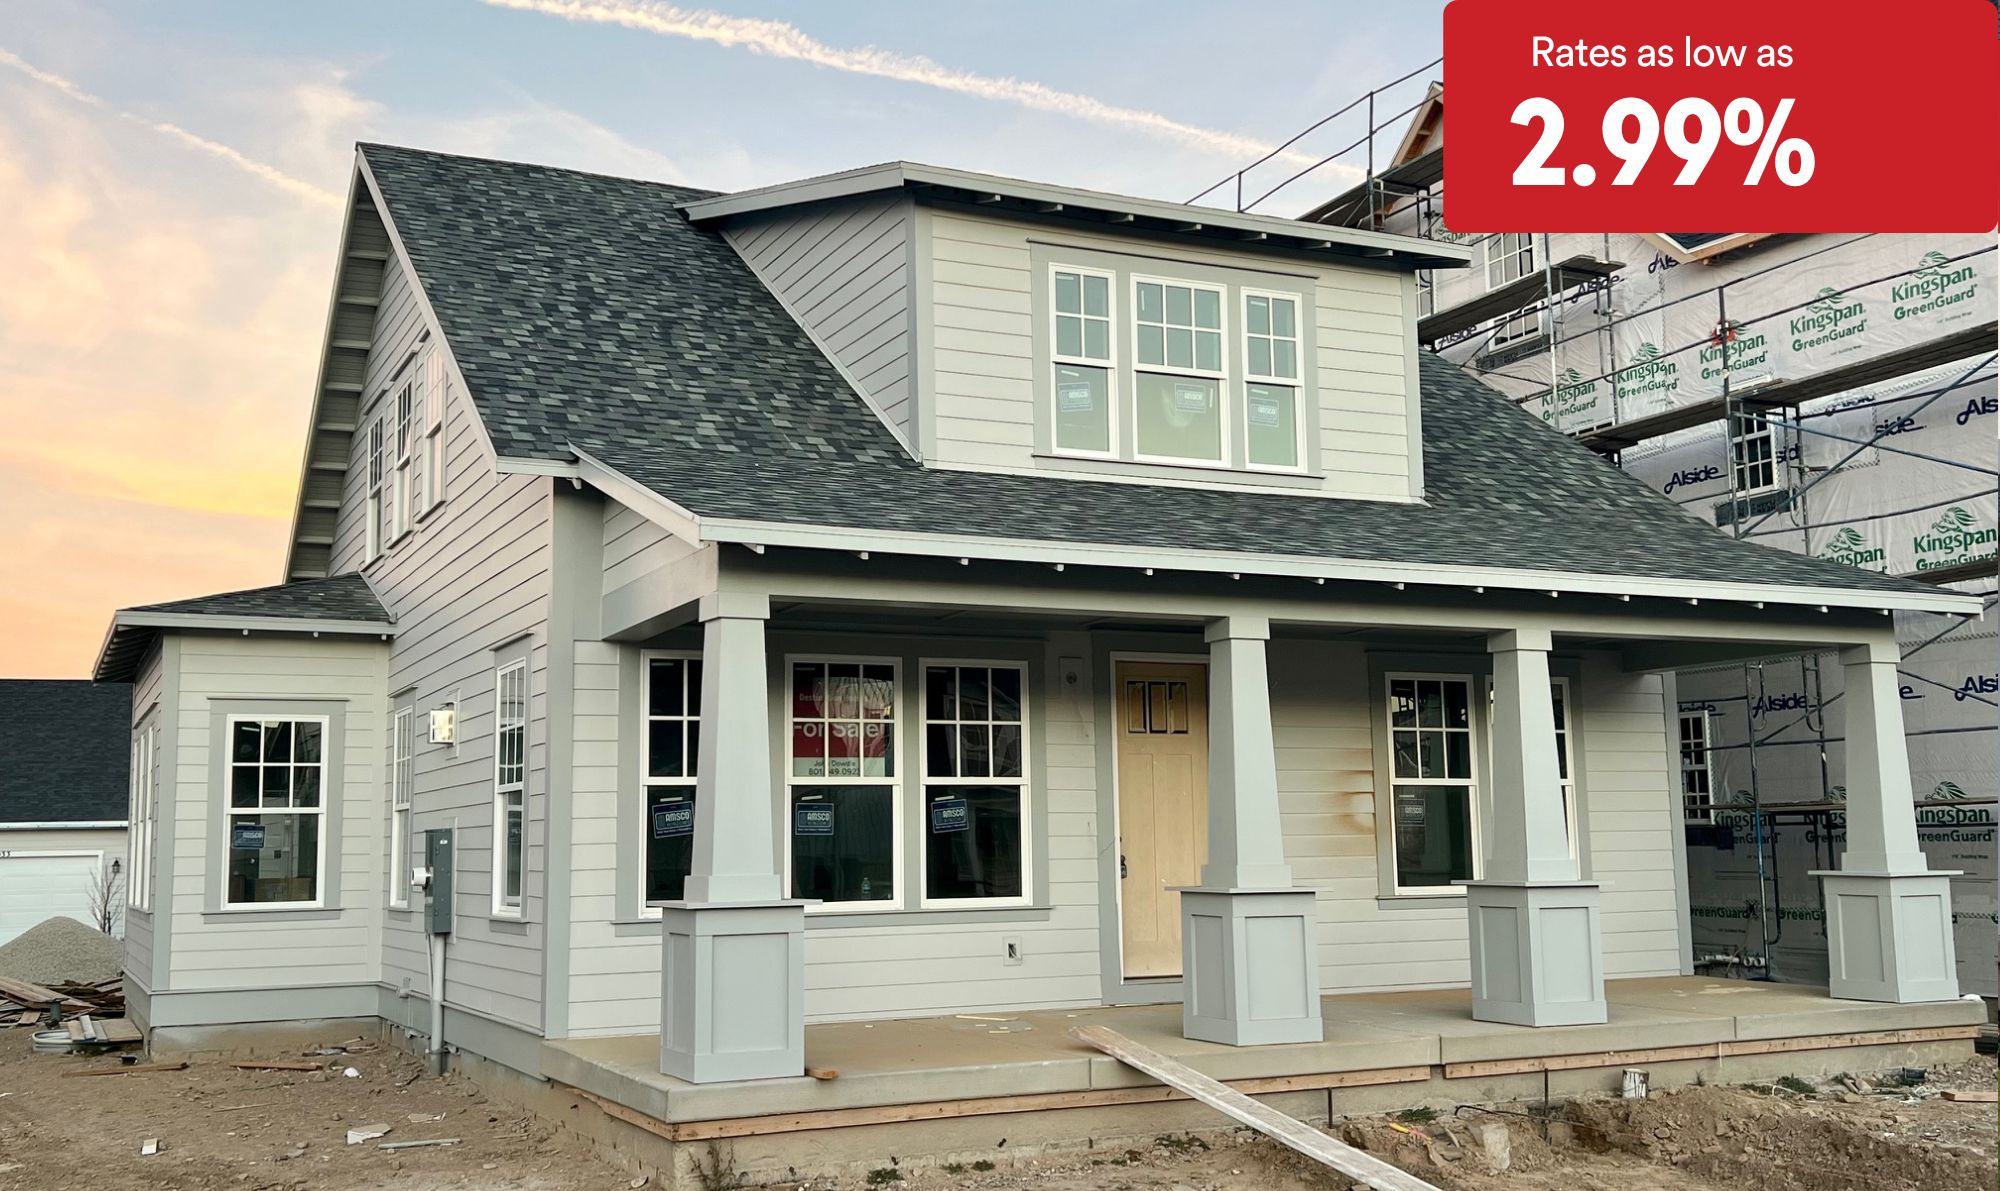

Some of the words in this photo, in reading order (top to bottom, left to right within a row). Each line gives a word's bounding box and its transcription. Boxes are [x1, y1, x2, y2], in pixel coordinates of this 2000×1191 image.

[1891, 266, 1973, 302] Kingspan
[1894, 286, 1976, 320] GreenGuard
[1790, 302, 1865, 335] Kingspan
[1792, 322, 1866, 351] GreenGuard
[1617, 361, 1677, 385] Kingspan
[1701, 351, 1767, 380] GrenGuard
[1543, 398, 1597, 421] GrenGuard
[1663, 464, 1728, 495] Alside
[1913, 528, 1997, 555] Kingspan
[1752, 692, 1817, 719] Alside
[665, 811, 690, 822] AMSCO
[807, 812, 830, 821] AMSCO
